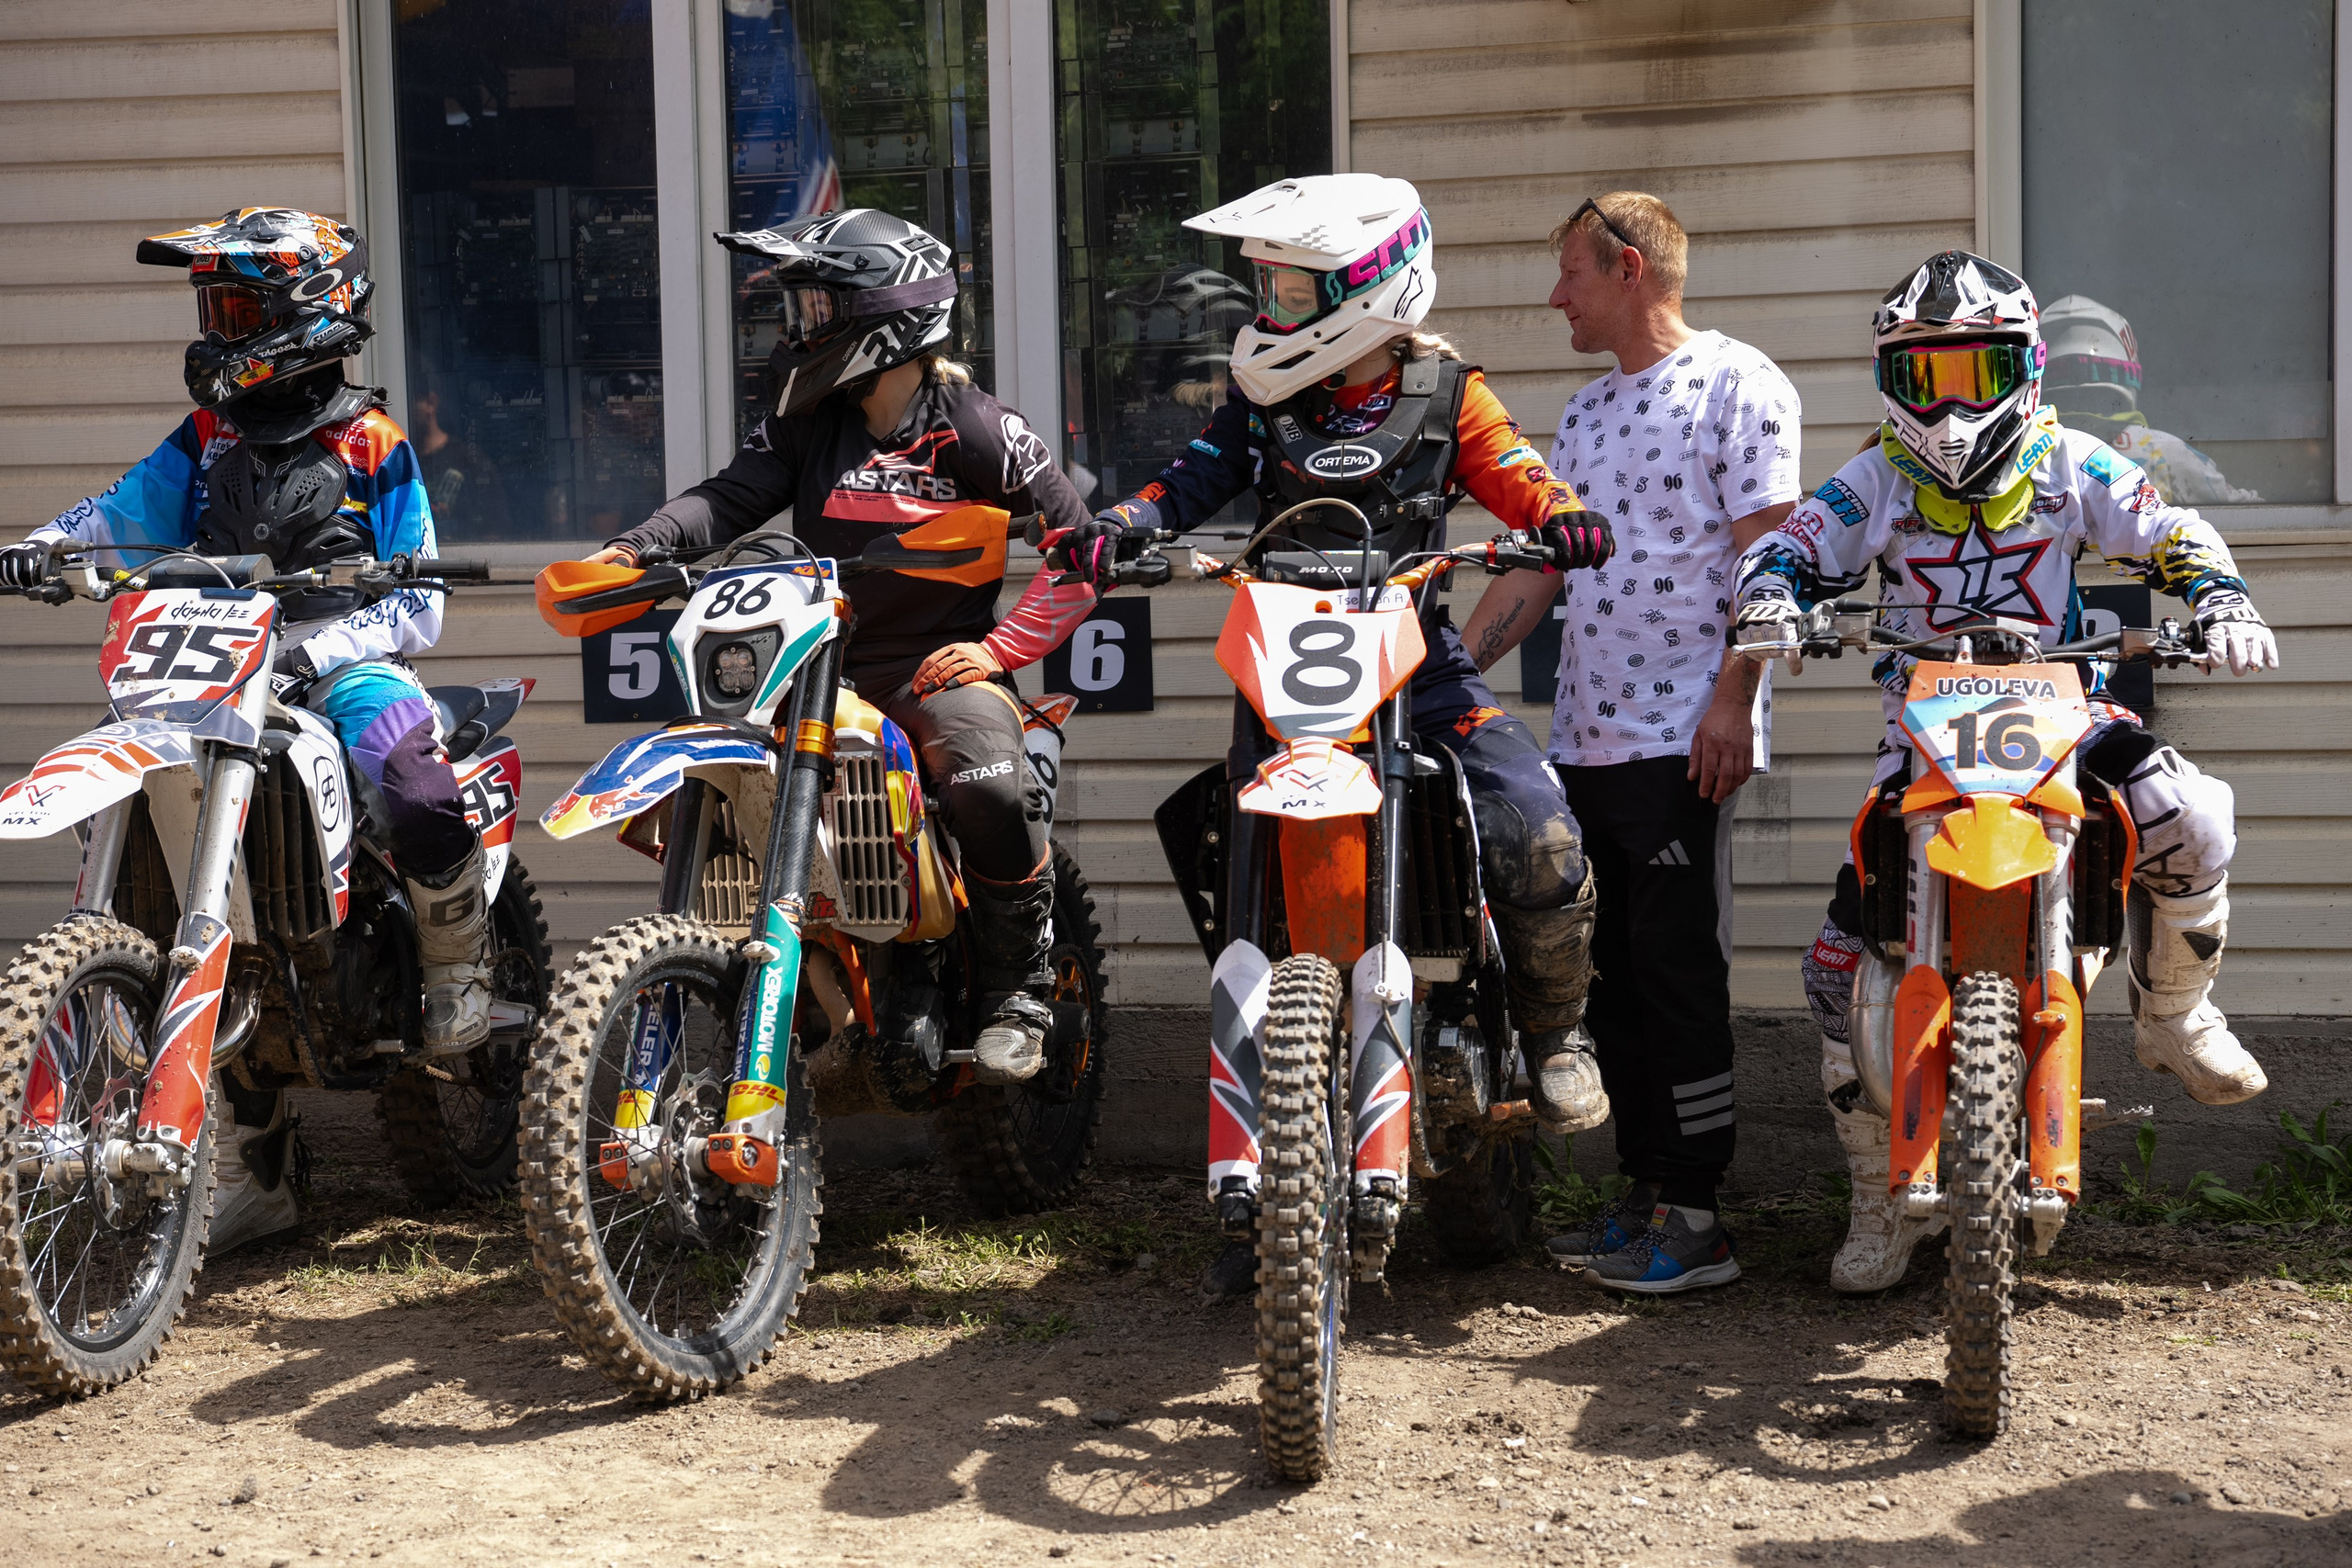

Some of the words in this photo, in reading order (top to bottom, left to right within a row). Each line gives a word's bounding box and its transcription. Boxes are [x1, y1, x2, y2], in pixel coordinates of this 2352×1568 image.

[1687, 376, 1704, 391] 96
[1634, 400, 1652, 415] 96
[1761, 419, 1781, 436] 96
[325, 429, 371, 447] adidas
[1315, 456, 1370, 468] ORTEMA
[835, 469, 956, 501] ASTARS
[1576, 479, 1589, 498] 96
[1664, 473, 1683, 491] 96
[1615, 499, 1630, 515] 96
[1831, 478, 1869, 518] RACING
[1654, 576, 1674, 594] 96
[704, 578, 778, 620] 86
[1597, 597, 1614, 615] 96
[111, 626, 258, 682] 95
[1069, 619, 1125, 692] 6
[1282, 620, 1363, 706] 8
[609, 632, 661, 700] 5
[1654, 680, 1674, 696] 96
[1938, 679, 2056, 698] UGOLEVA
[1597, 700, 1617, 718] 96
[1947, 712, 2041, 771] 16
[950, 760, 1013, 786] ASTARS
[461, 763, 515, 830] 95
[757, 966, 783, 1053] MOTOREX
